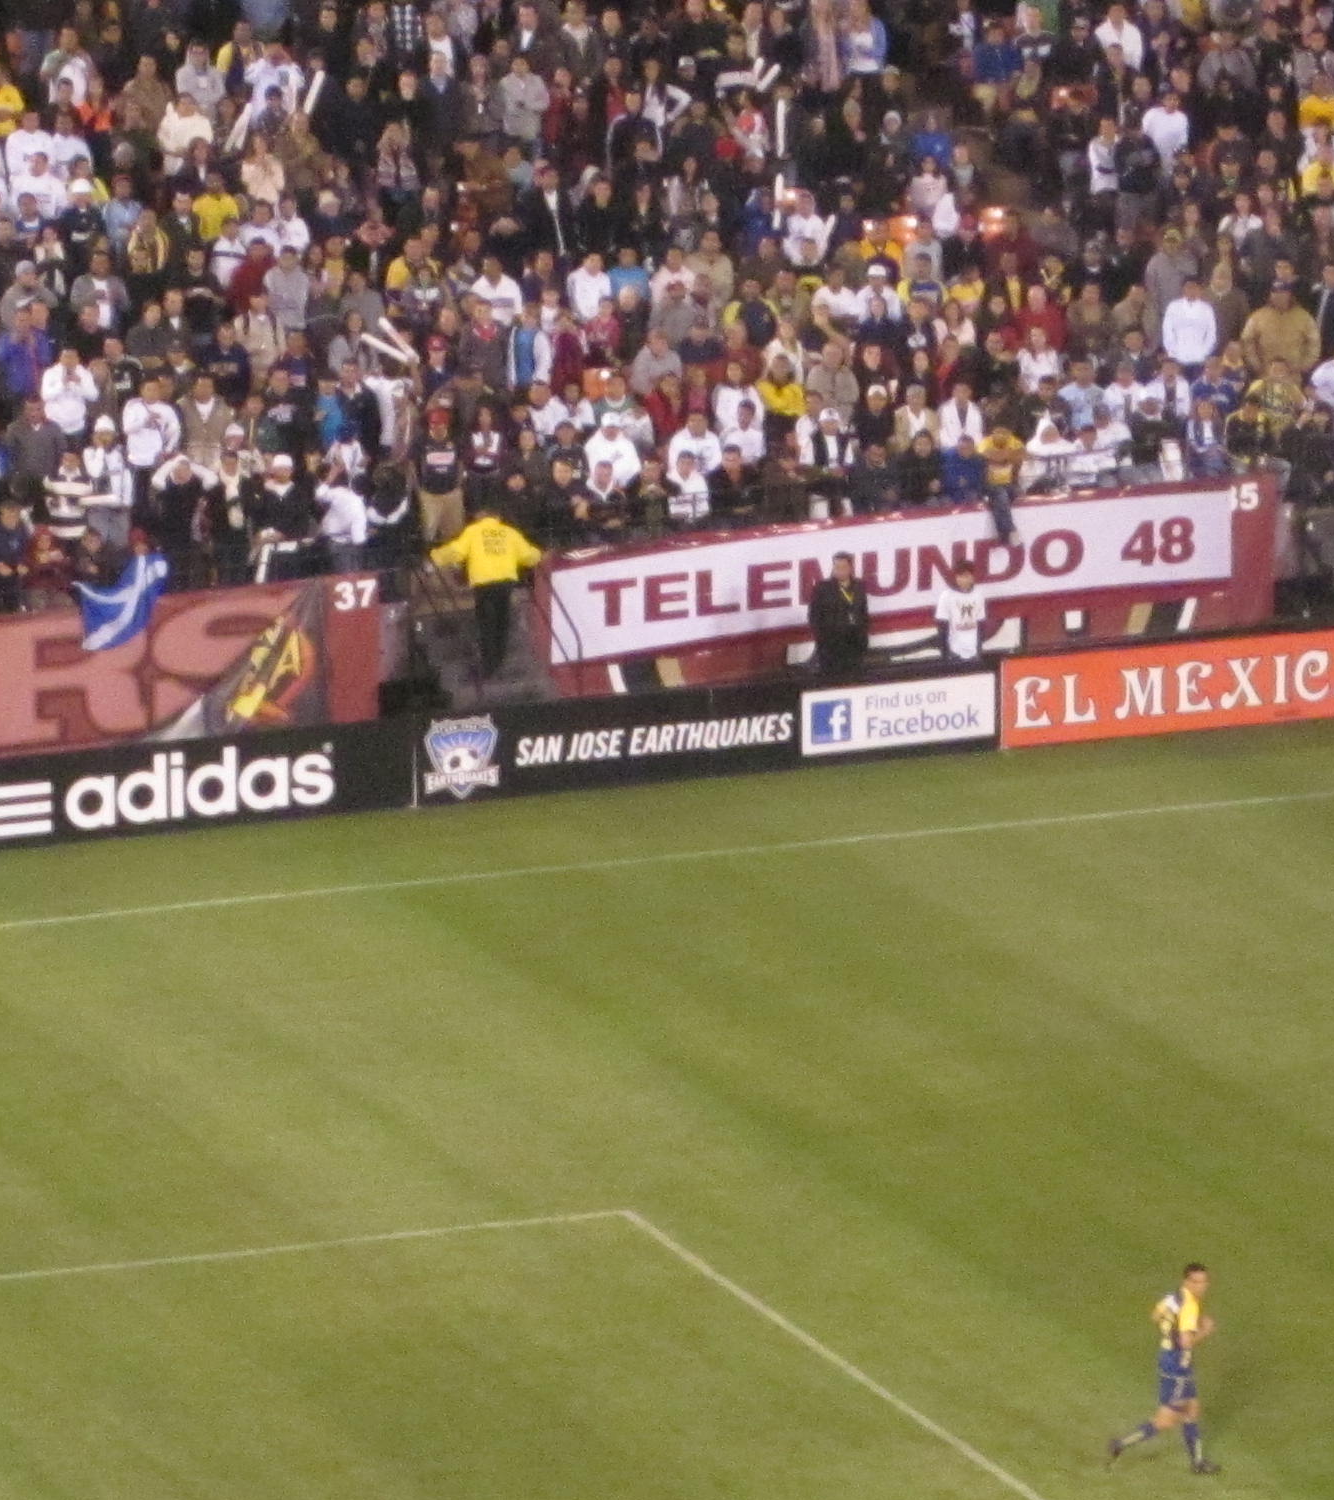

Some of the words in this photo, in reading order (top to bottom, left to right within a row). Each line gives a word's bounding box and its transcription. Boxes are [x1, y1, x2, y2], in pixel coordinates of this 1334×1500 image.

[1121, 517, 1195, 567] 48
[333, 580, 378, 611] 37
[865, 693, 900, 710] Find
[905, 694, 923, 706] us
[927, 691, 948, 704] on
[867, 704, 980, 738] Facebook
[1014, 674, 1097, 729] EL
[516, 734, 562, 767] SAN
[567, 729, 623, 762] JOSE
[629, 712, 794, 757] EARTHQUAKES
[65, 746, 335, 829] adidas
